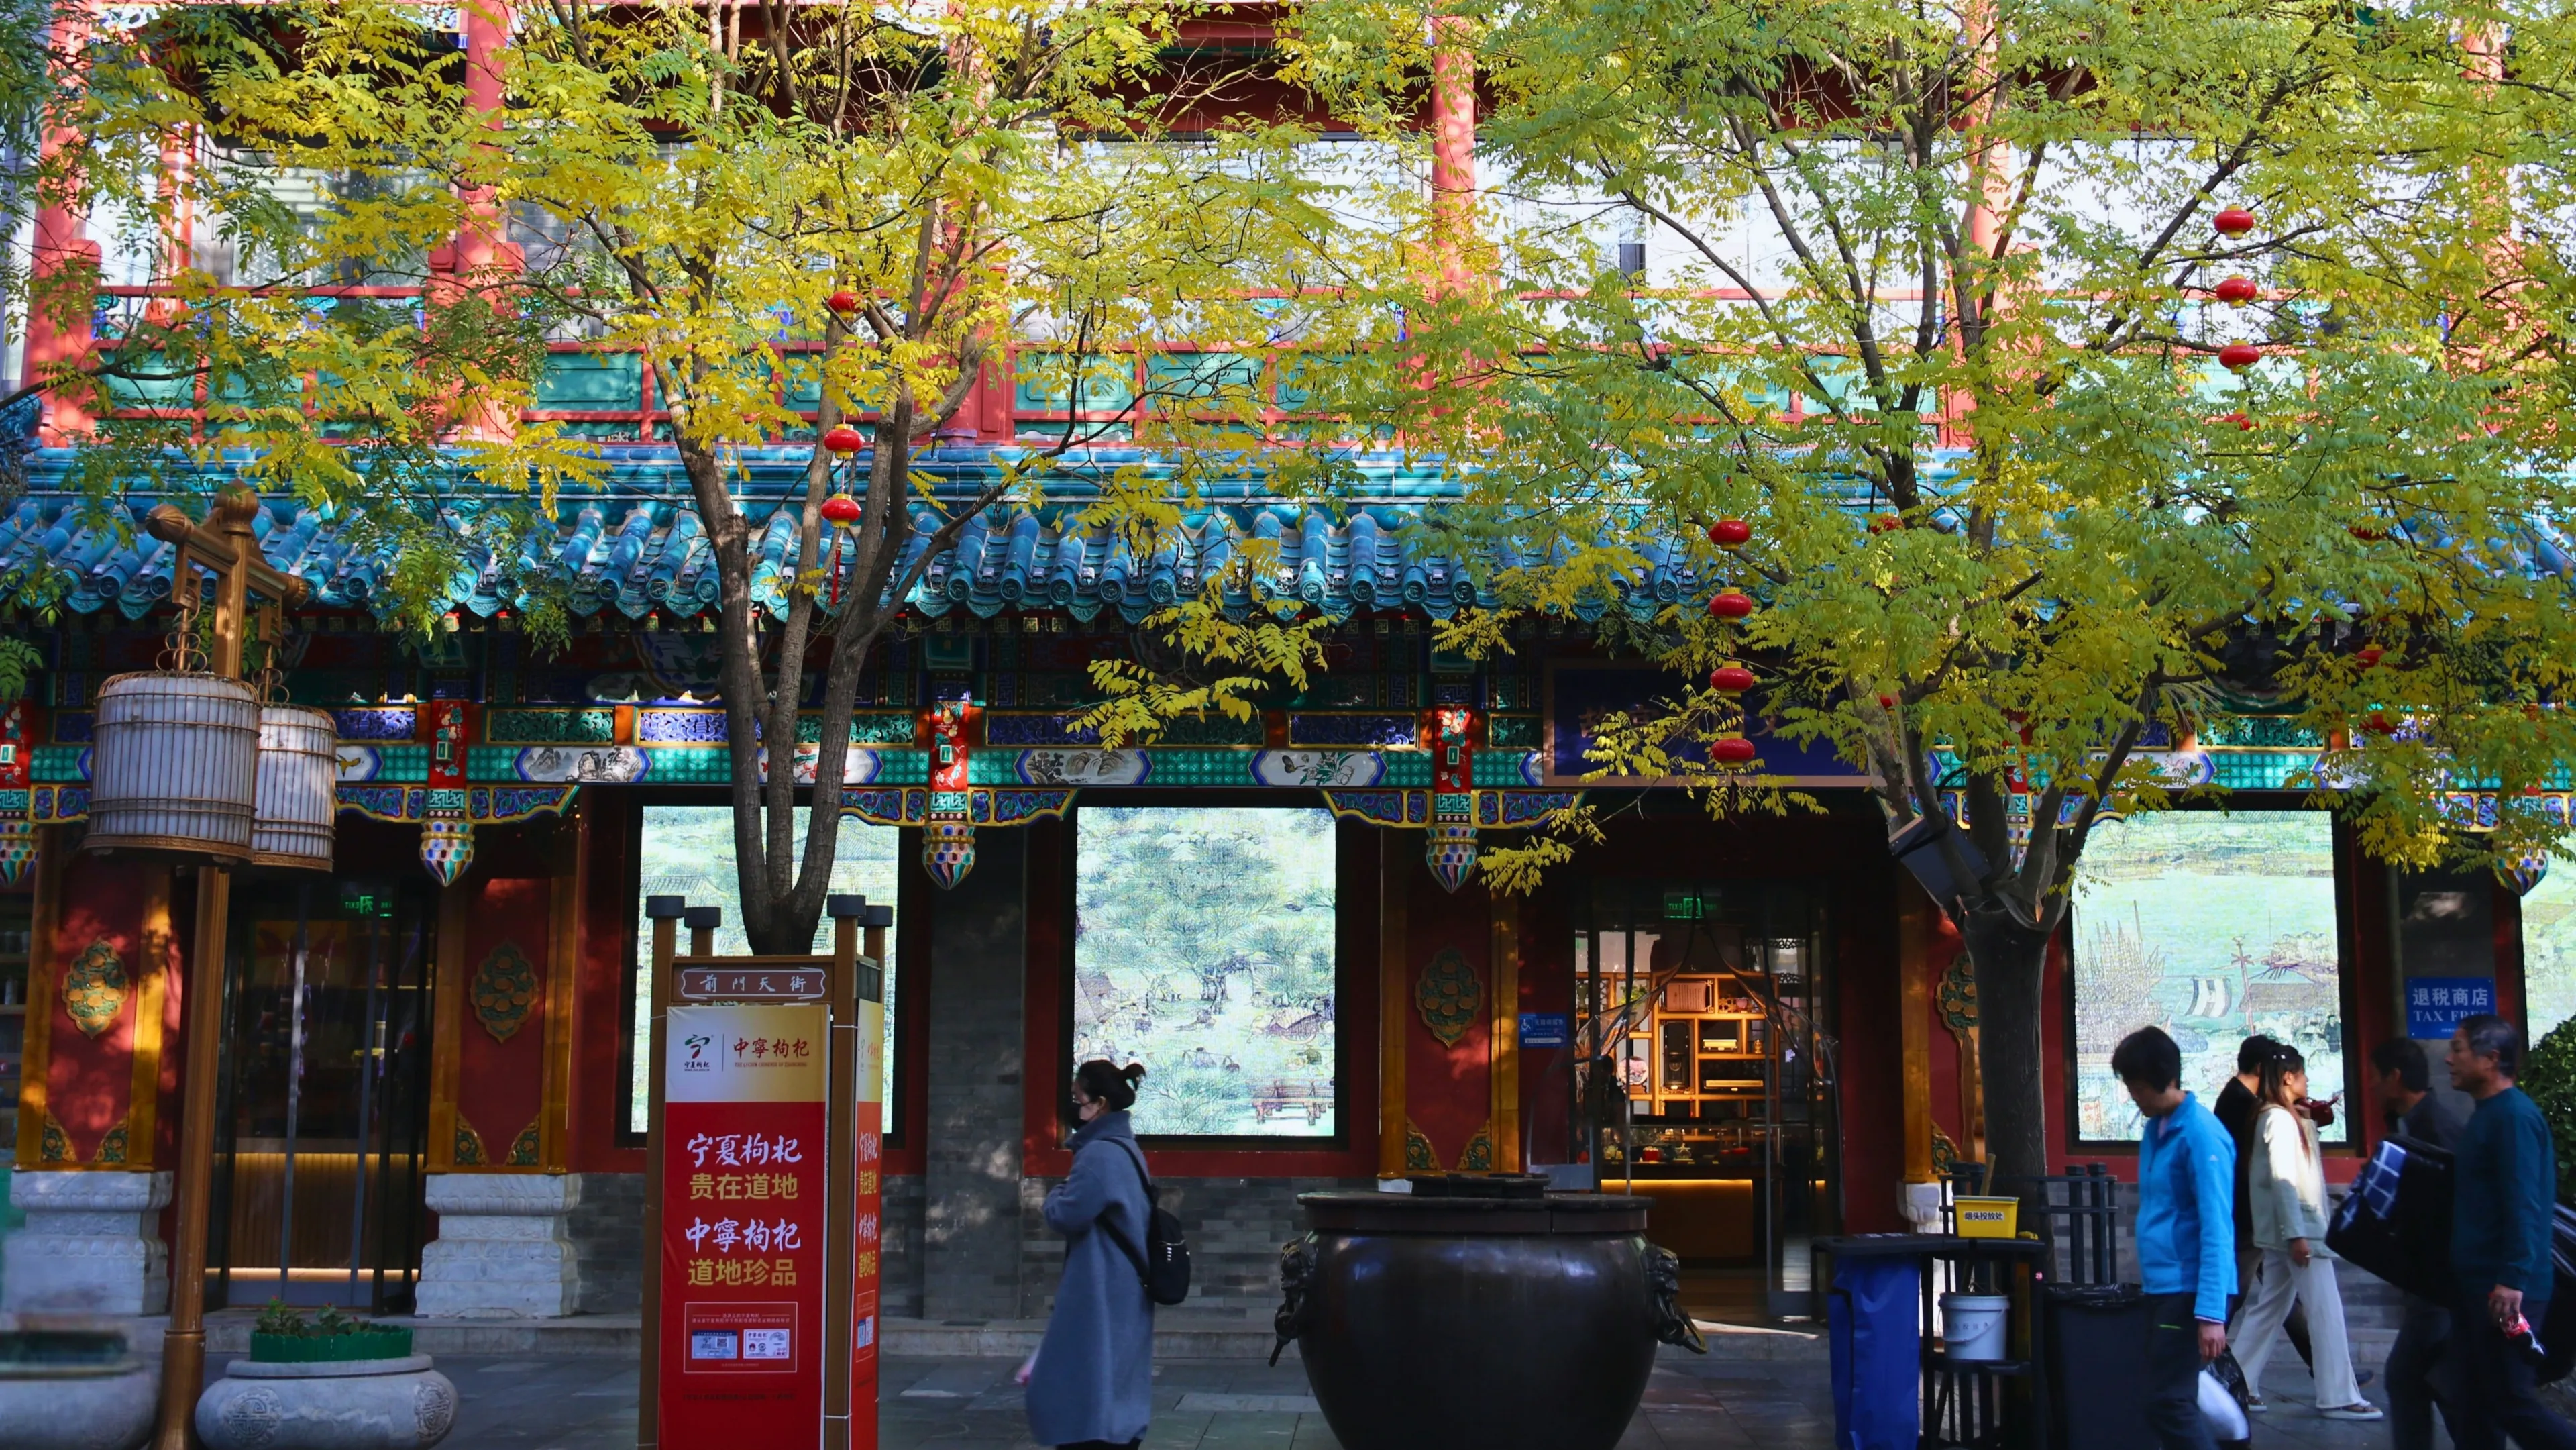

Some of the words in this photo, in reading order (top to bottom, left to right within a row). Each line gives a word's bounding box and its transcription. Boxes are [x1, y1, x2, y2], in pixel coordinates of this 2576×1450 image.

[2413, 988, 2488, 1006] 退税商店
[2414, 1011, 2444, 1022] TAX
[687, 1133, 802, 1167] 宁夏枸杞
[689, 1173, 798, 1200] 贵在道地
[688, 1259, 796, 1286] 道地珍品
